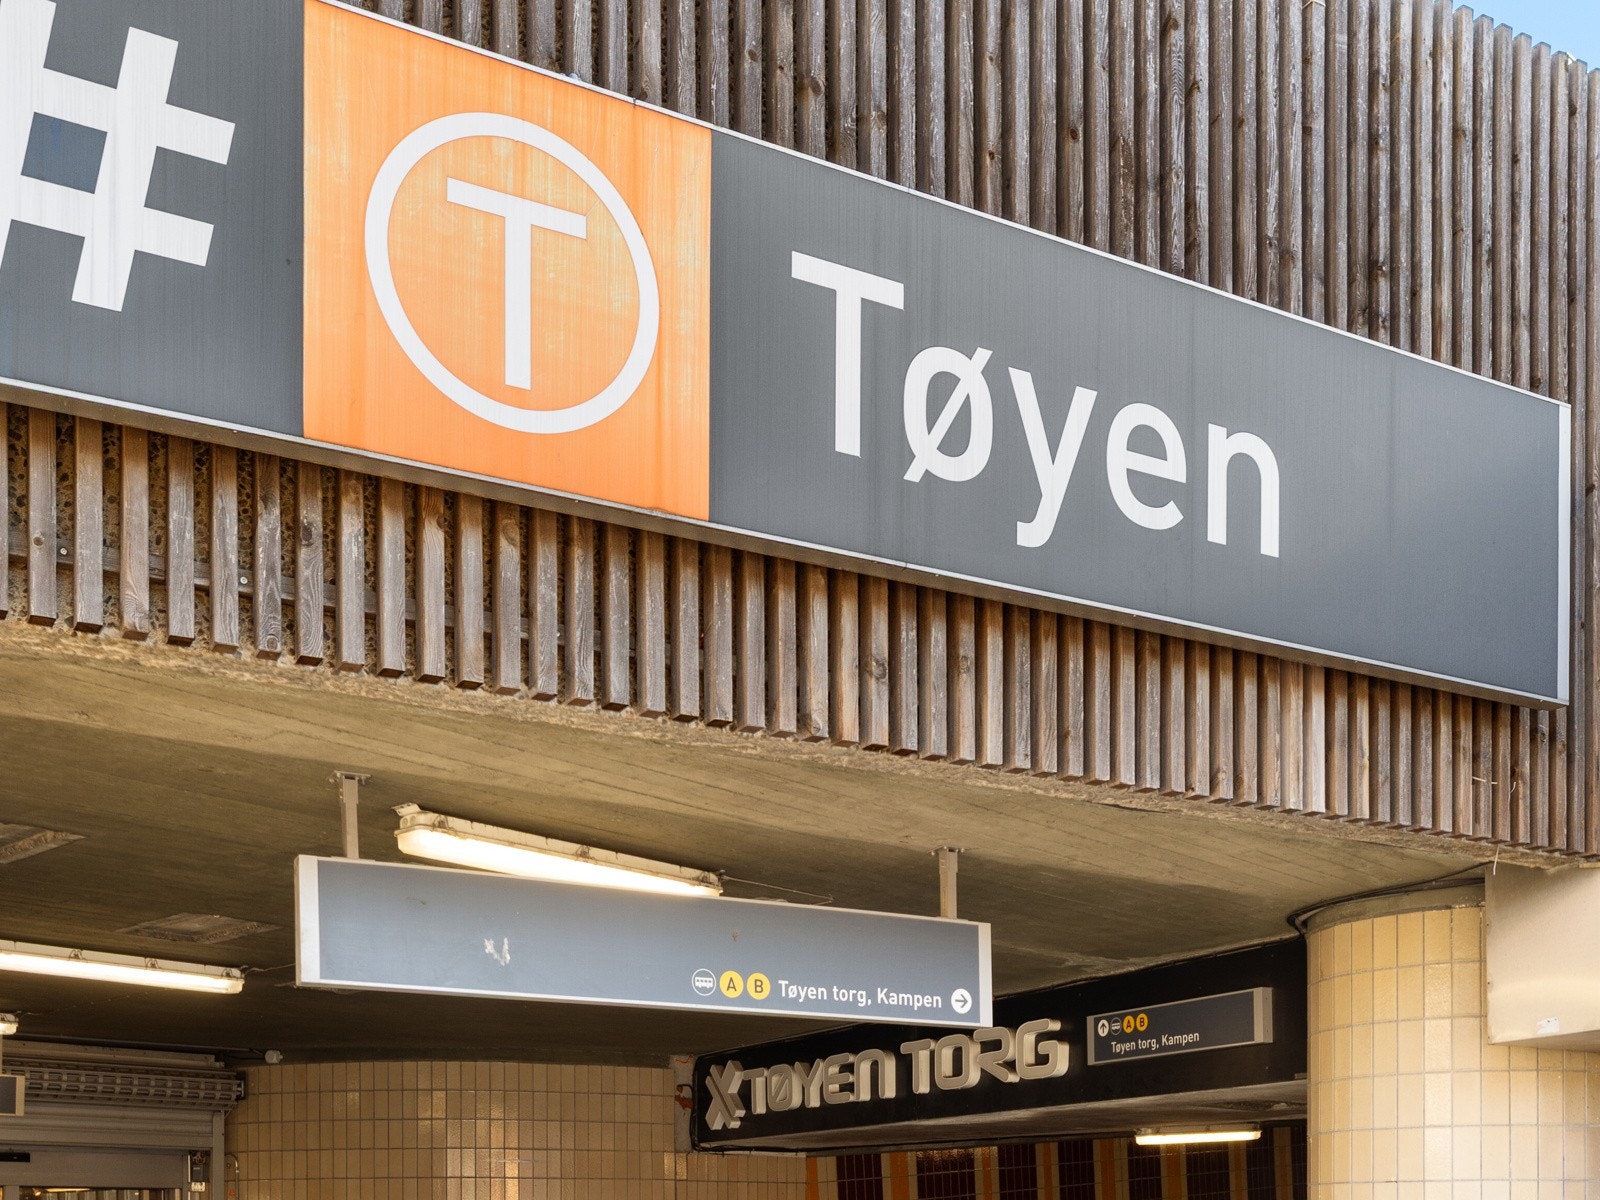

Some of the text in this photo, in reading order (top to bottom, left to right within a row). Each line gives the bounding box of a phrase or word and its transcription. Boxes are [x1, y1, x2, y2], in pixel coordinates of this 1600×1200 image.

[791, 250, 1280, 558] Tøyen
[778, 979, 828, 1002] Tøyen
[832, 985, 872, 1007] torg,
[877, 988, 943, 1010] Kampen
[742, 1047, 897, 1116] TØYEN
[900, 1018, 1070, 1095] TORG
[1111, 1032, 1200, 1054] Tøyen torg, Kampen
